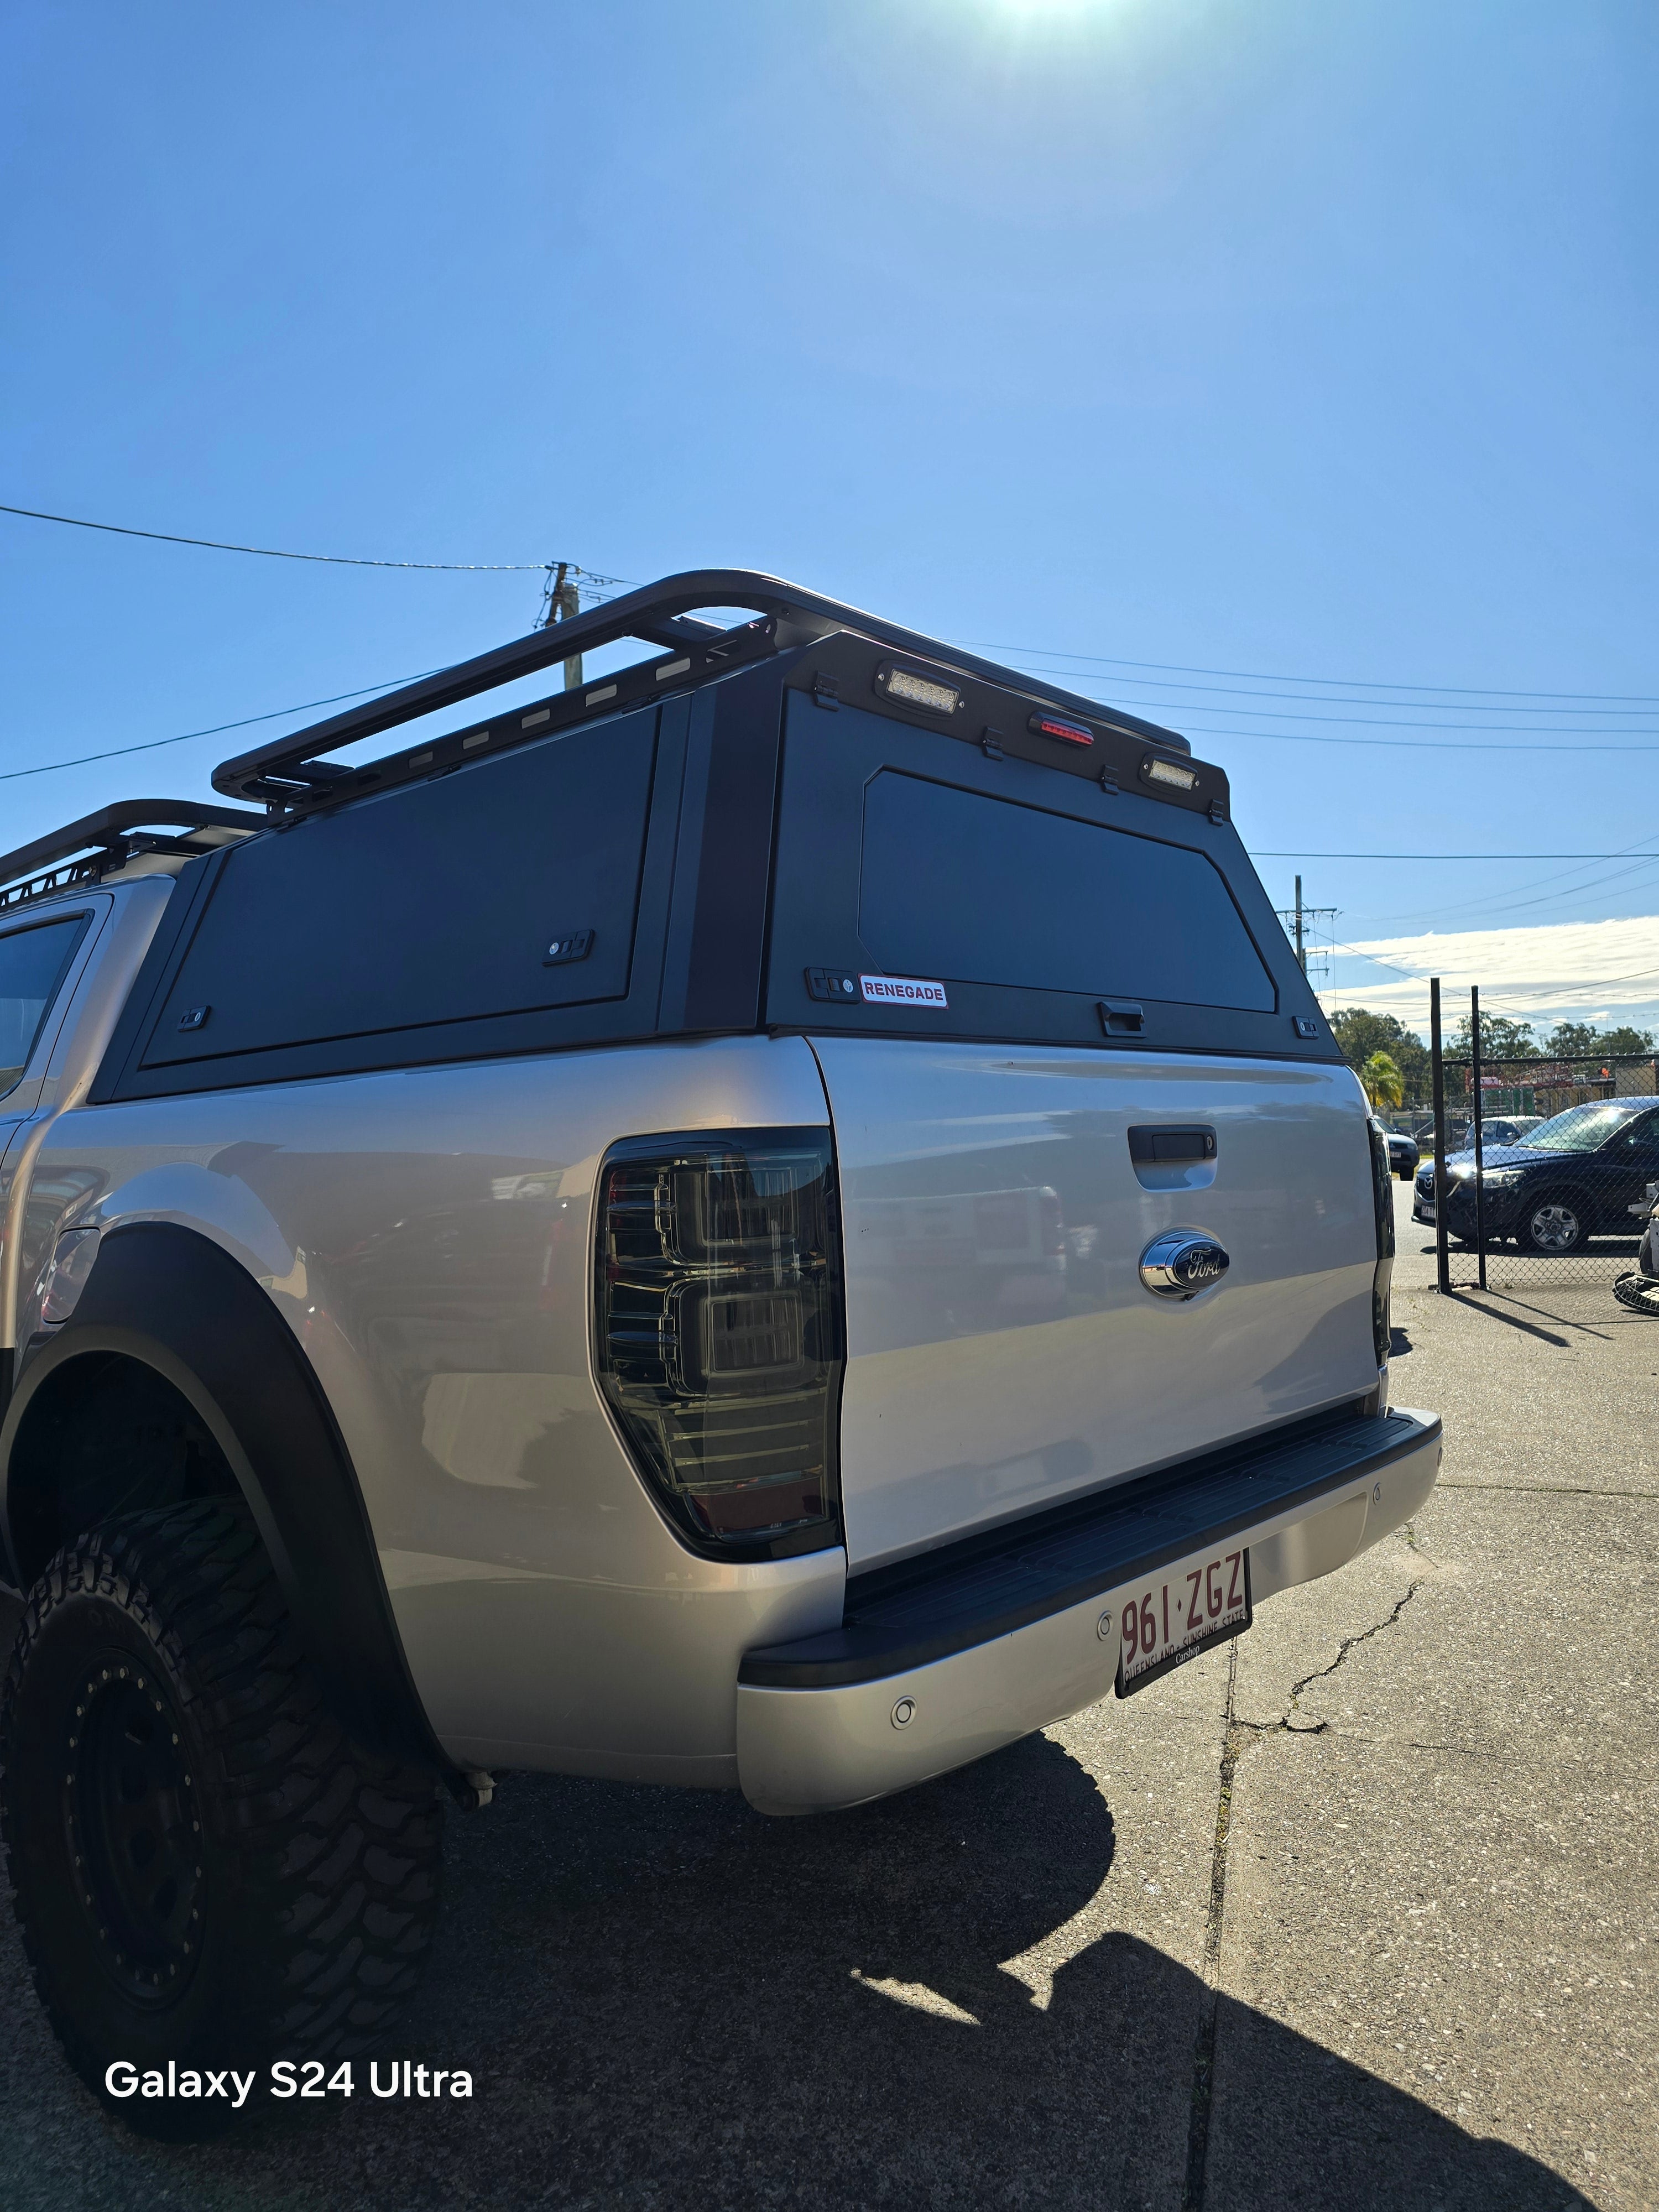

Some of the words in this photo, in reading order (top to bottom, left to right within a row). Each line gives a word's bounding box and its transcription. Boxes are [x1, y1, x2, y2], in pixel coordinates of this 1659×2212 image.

[864, 981, 944, 1001] RENEGADE
[1187, 1248, 1221, 1280] Ford
[1183, 1621, 1218, 1647] SUNSHINE
[1222, 1609, 1243, 1627] STATE
[1175, 1645, 1200, 1664] Carshop
